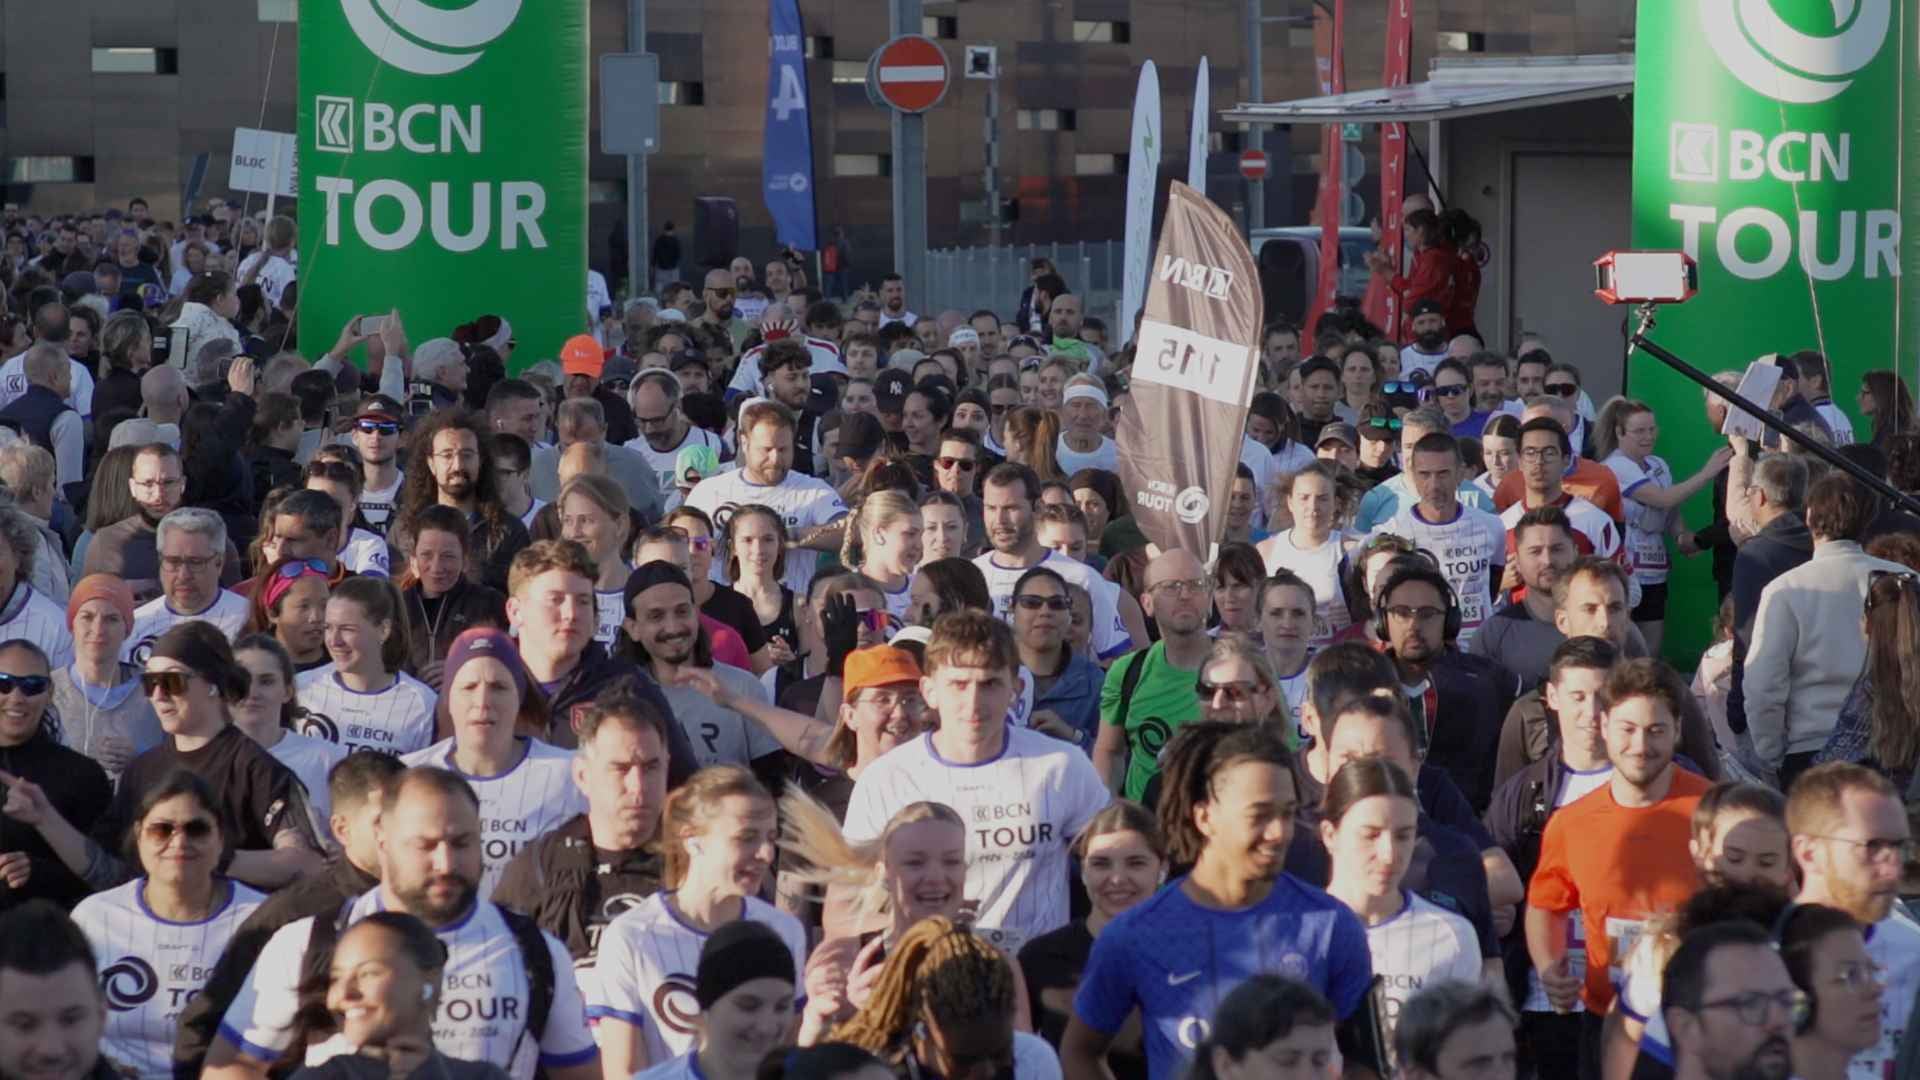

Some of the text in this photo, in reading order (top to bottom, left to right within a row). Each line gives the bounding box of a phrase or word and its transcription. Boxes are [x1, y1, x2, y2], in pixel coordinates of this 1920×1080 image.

[364, 102, 482, 153] BCN
[234, 154, 268, 170] BLOC
[1729, 131, 1850, 183] BCN
[315, 175, 549, 252] TOUR
[1669, 204, 1904, 281] TOUR
[363, 727, 395, 743] BCN
[993, 803, 1032, 819] BCN
[490, 819, 528, 832] BCN
[975, 823, 1053, 849] TOUR
[447, 973, 492, 990] BCN
